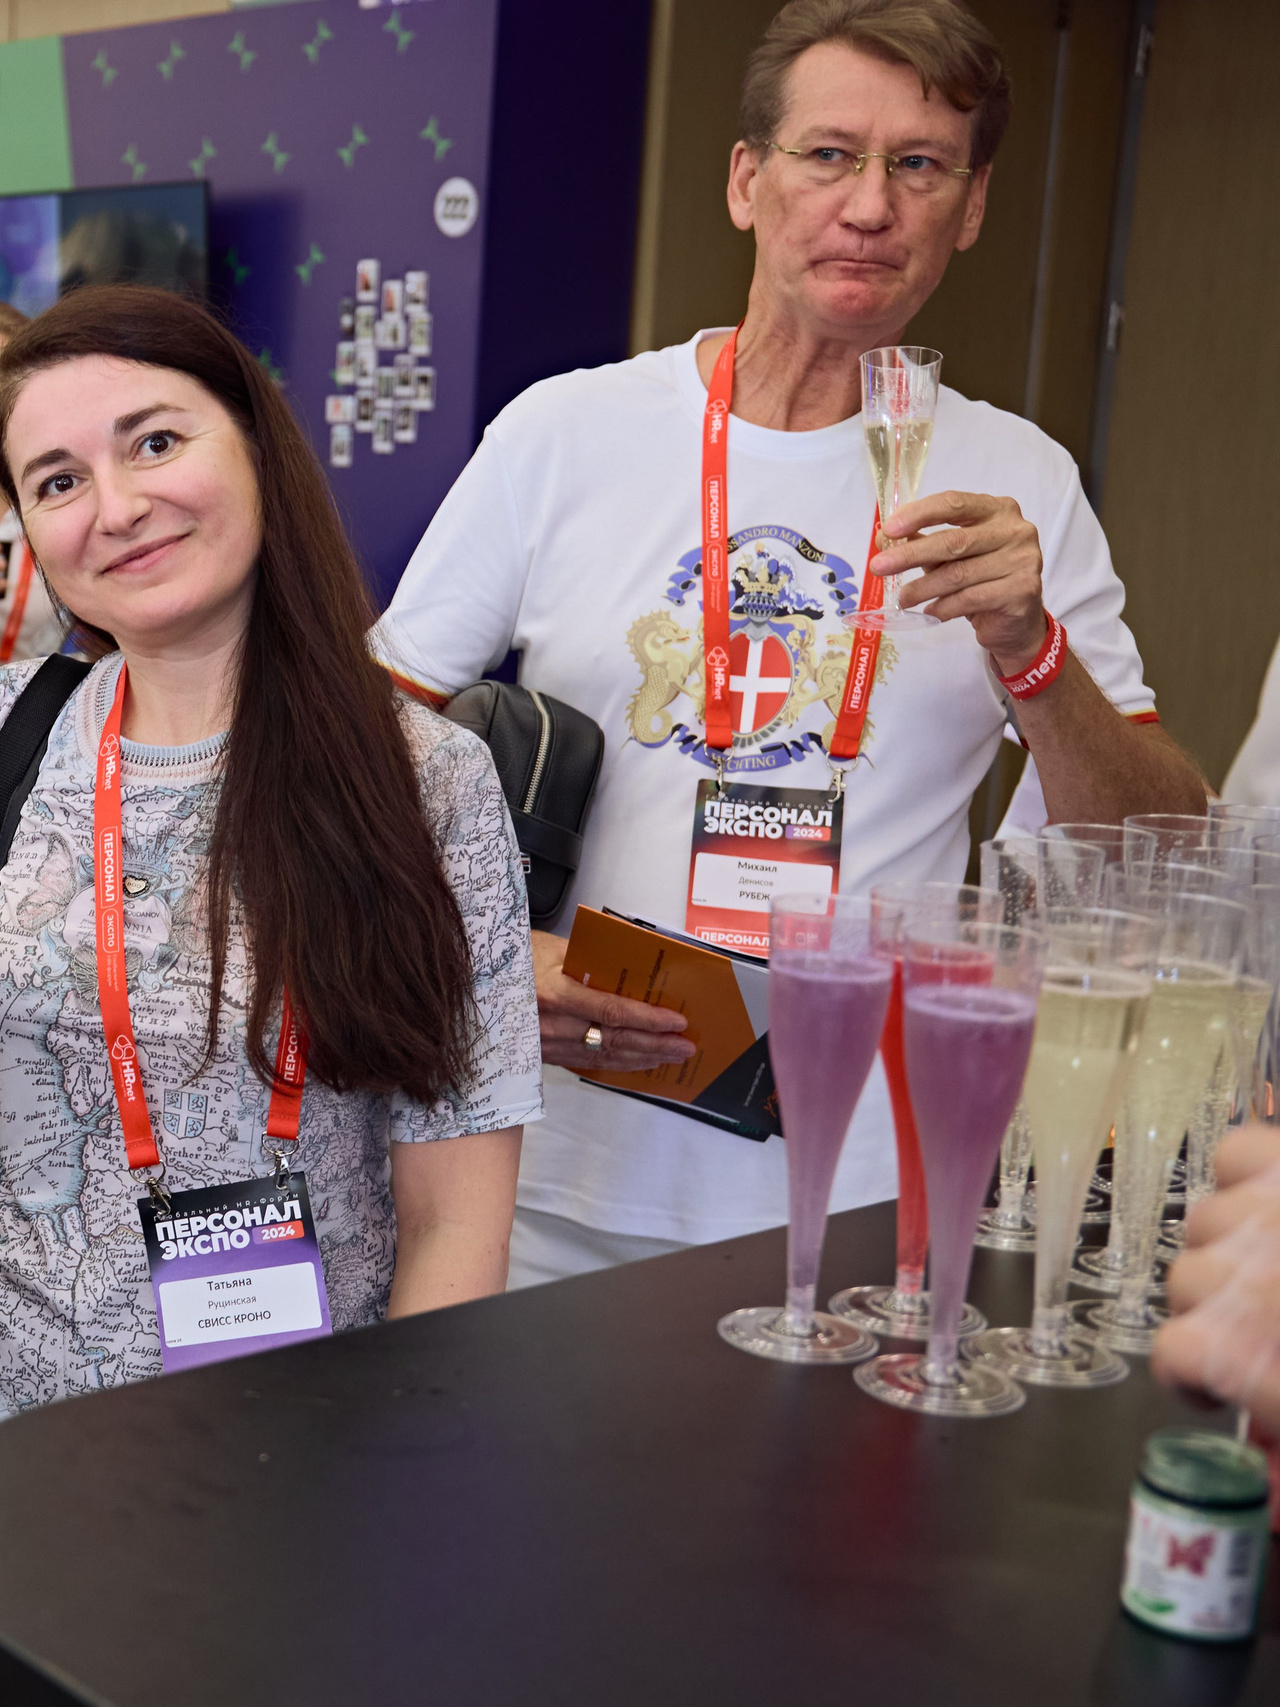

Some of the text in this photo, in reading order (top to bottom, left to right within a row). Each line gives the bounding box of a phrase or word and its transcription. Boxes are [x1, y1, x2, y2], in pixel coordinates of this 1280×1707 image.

[710, 412, 722, 444] HRnet
[709, 480, 720, 538] ПЕРСОНАЛ
[779, 529, 827, 563] MANZONI
[710, 548, 719, 577] ЭКСПО
[713, 666, 726, 700] HRnet
[849, 647, 871, 710] ПЕРСОНАЛ
[104, 755, 117, 791] HRnet
[704, 800, 833, 827] ПЕРСОНАЛ
[703, 817, 823, 840] ЭКСПО 2024
[737, 861, 778, 873] Михаил
[103, 832, 116, 948] ПЕРСОНАЛ ЭКСПО
[738, 876, 774, 888] Денисов
[739, 890, 770, 901] РУБЕЖ
[701, 931, 770, 947] ПЕРСОНАЛ
[121, 1060, 136, 1103] HRnet
[236, 1192, 299, 1209] HR-Форум
[154, 1199, 302, 1242] ПЕРСОНАЛ
[159, 1225, 296, 1261] ЭКСПО 2024
[207, 1277, 252, 1291] Татьяна
[207, 1296, 257, 1310] Руцинская
[12, 1317, 58, 1346] WALES
[198, 1310, 272, 1329] СВИСС КРОНО
